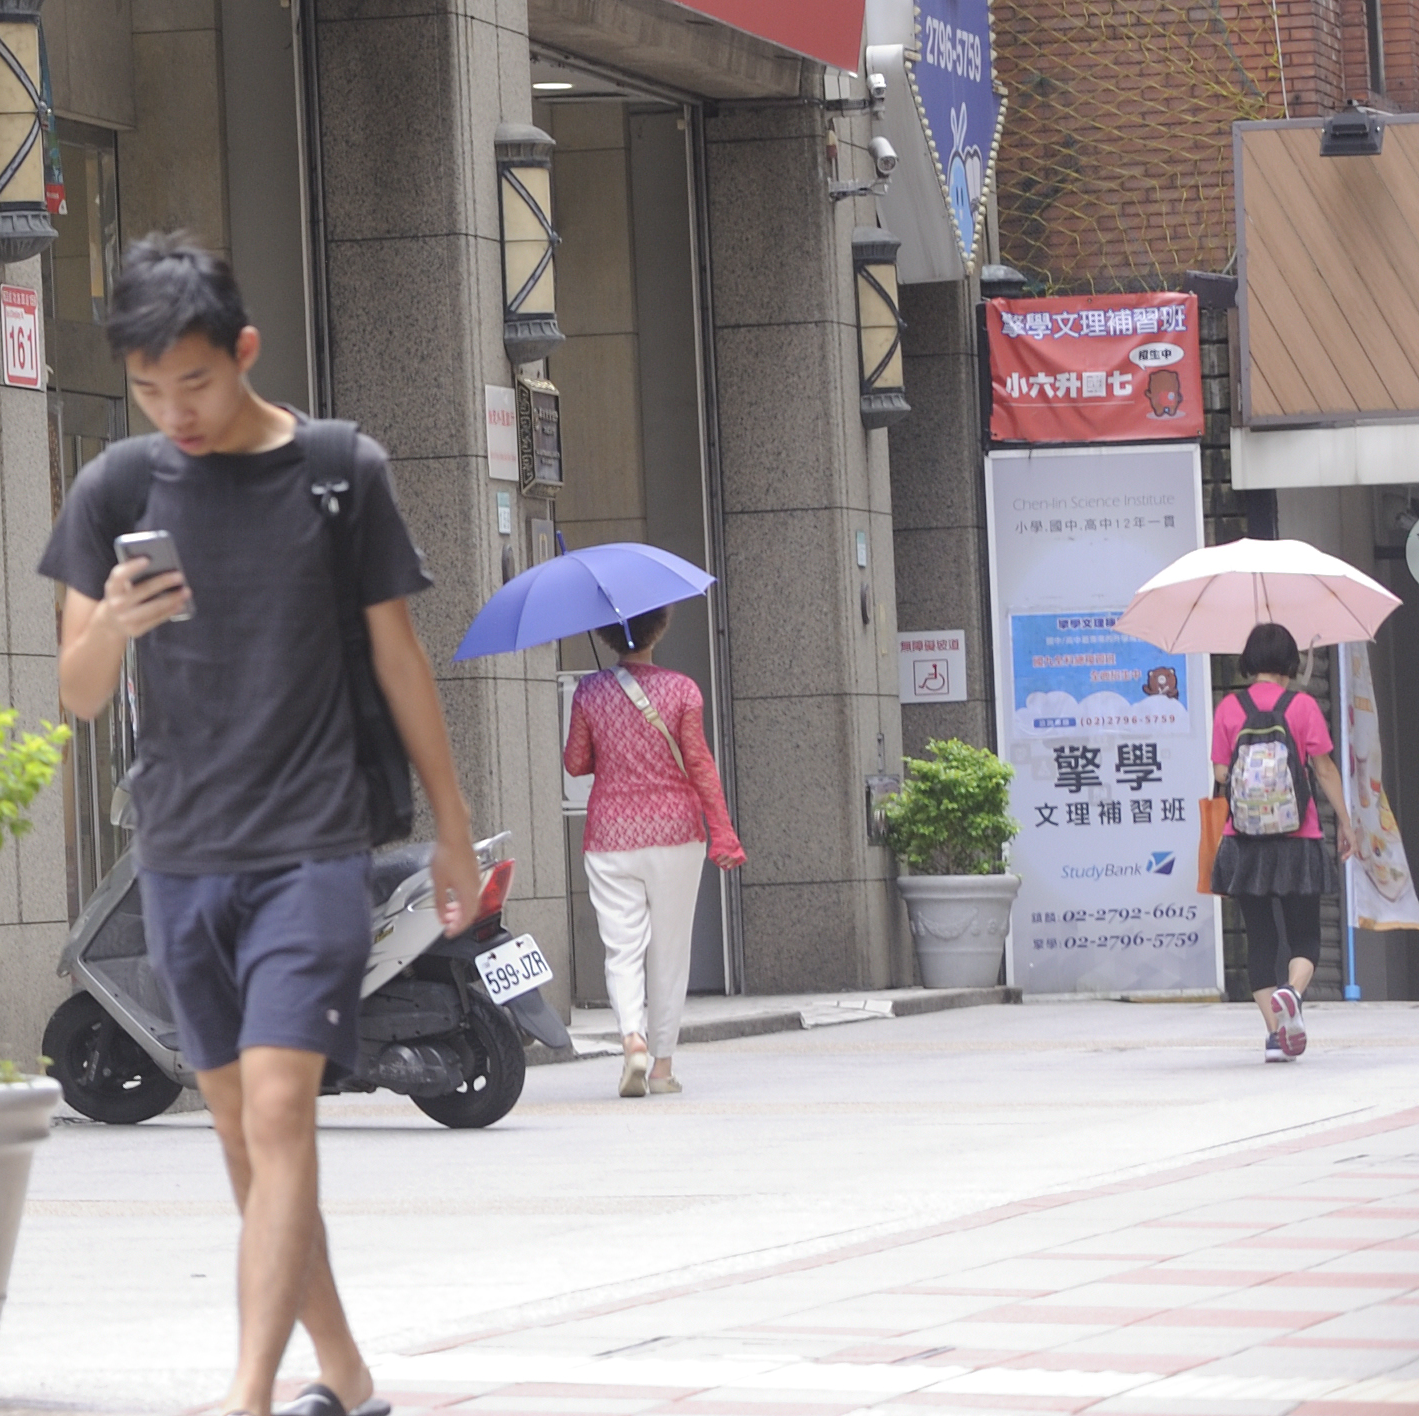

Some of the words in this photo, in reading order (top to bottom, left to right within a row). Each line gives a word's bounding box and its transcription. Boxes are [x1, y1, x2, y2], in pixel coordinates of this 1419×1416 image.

[925, 15, 983, 83] 2796-5759
[1001, 305, 1188, 339] 擎學文理補習班
[9, 326, 36, 371] 161
[1006, 370, 1133, 398] 小六升國七
[1071, 496, 1120, 509] Science
[1124, 494, 1175, 507] Institute
[1080, 714, 1176, 727] (02)2796-5759
[1053, 742, 1163, 794] 擎學
[1034, 798, 1186, 828] 文理補習班
[1061, 862, 1142, 881] StudyBank
[1063, 902, 1198, 924] 02-2792-6615
[1064, 930, 1200, 951] 02-2796-5759
[485, 950, 549, 995] 599-JZR
